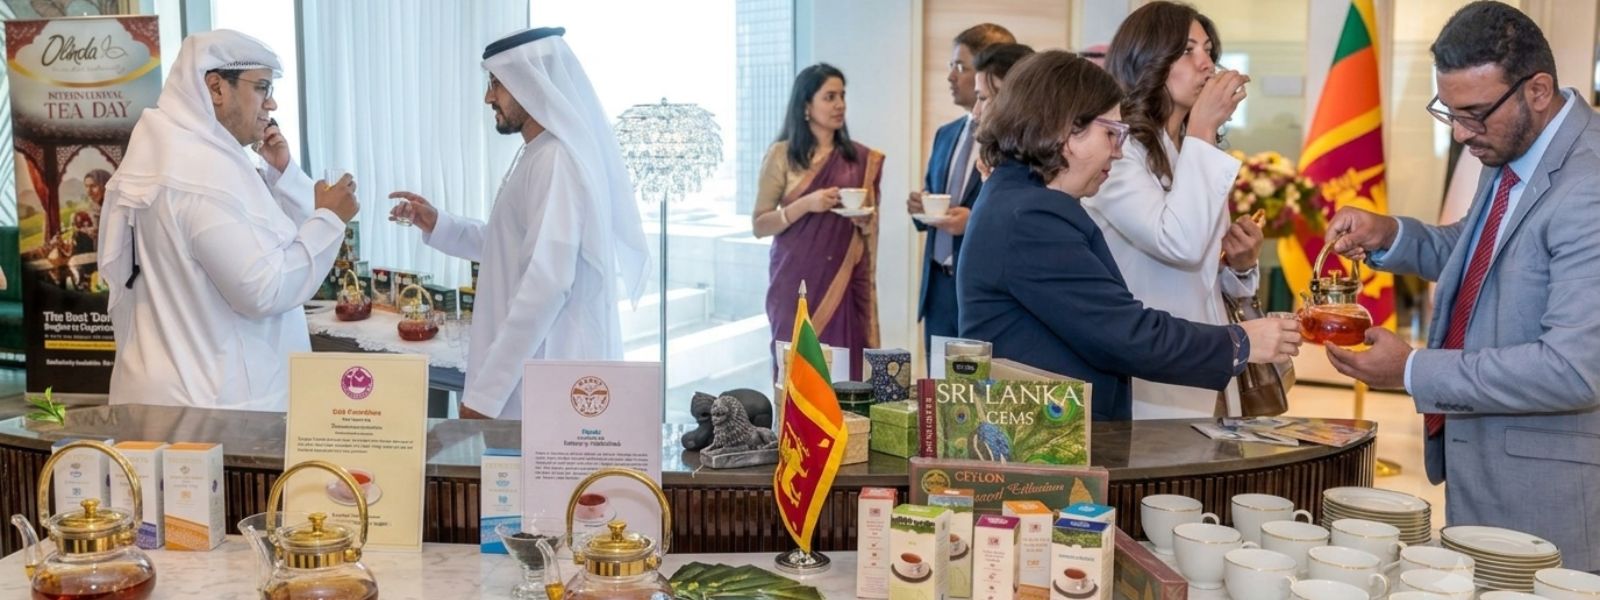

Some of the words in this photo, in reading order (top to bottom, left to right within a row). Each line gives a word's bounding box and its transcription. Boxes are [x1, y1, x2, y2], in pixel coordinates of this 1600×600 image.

[41, 34, 98, 66] Olinda
[43, 102, 83, 119] TEA
[92, 101, 132, 118] DAY
[937, 383, 974, 404] SRI
[985, 384, 1084, 407] LANKA
[954, 471, 1005, 483] CEYLON
